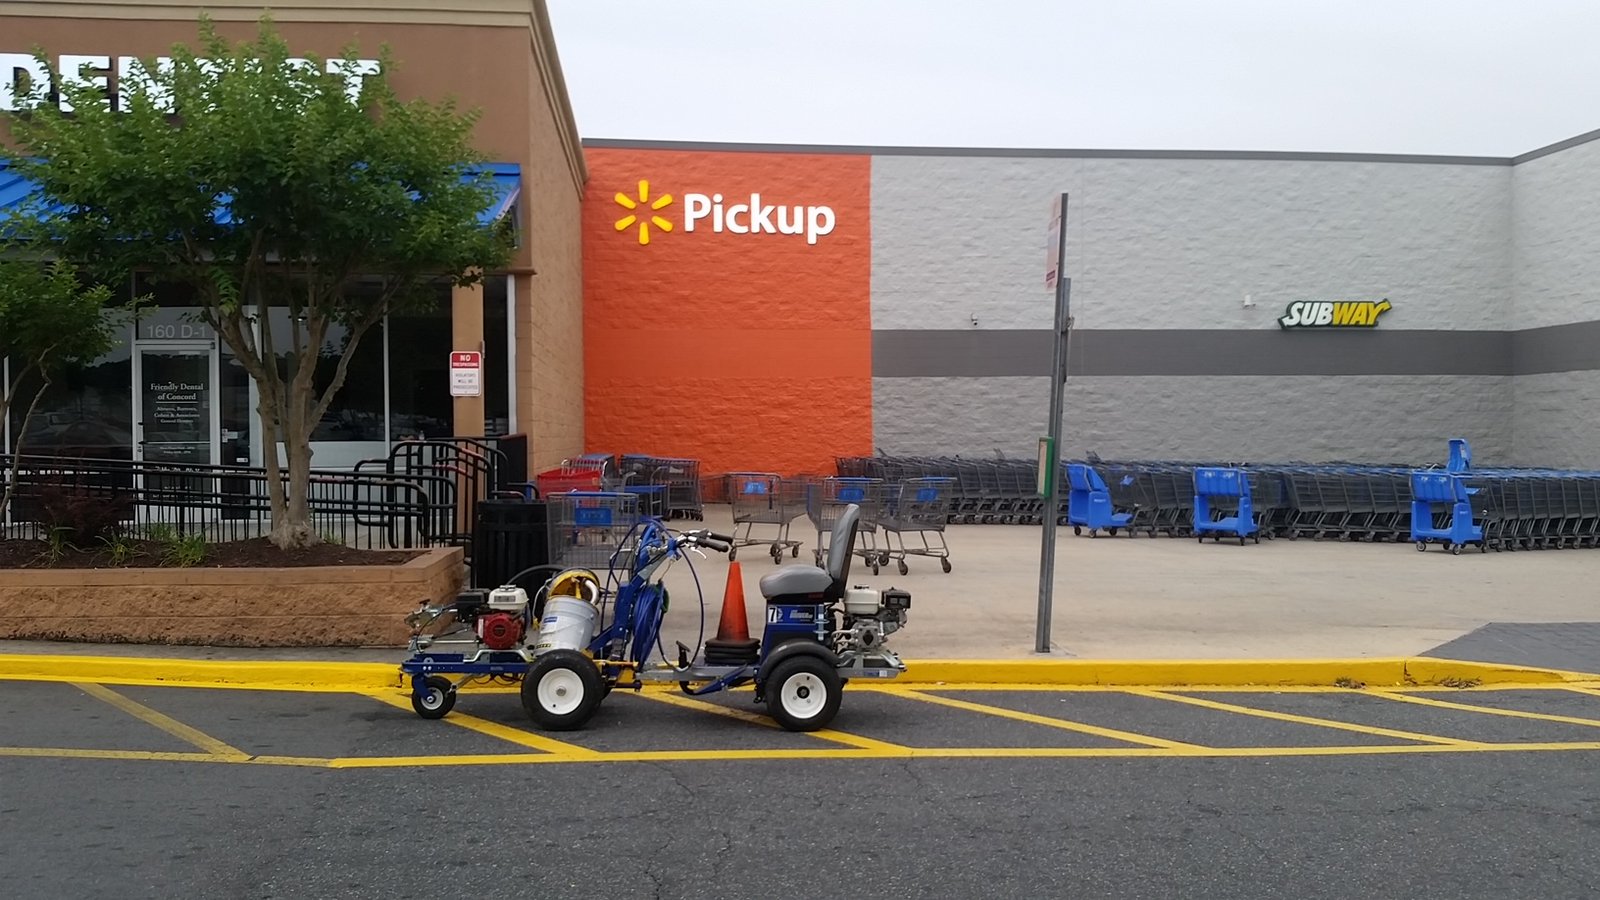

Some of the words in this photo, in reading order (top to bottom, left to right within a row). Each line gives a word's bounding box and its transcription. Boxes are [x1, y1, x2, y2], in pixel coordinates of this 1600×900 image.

[684, 193, 836, 245] Pickup
[1281, 301, 1392, 326] SUBWAY
[147, 325, 175, 338] 160
[181, 325, 206, 338] D-1
[460, 354, 471, 362] NO
[150, 383, 178, 391] Friendly
[157, 392, 166, 400] of
[166, 392, 197, 400] Concord
